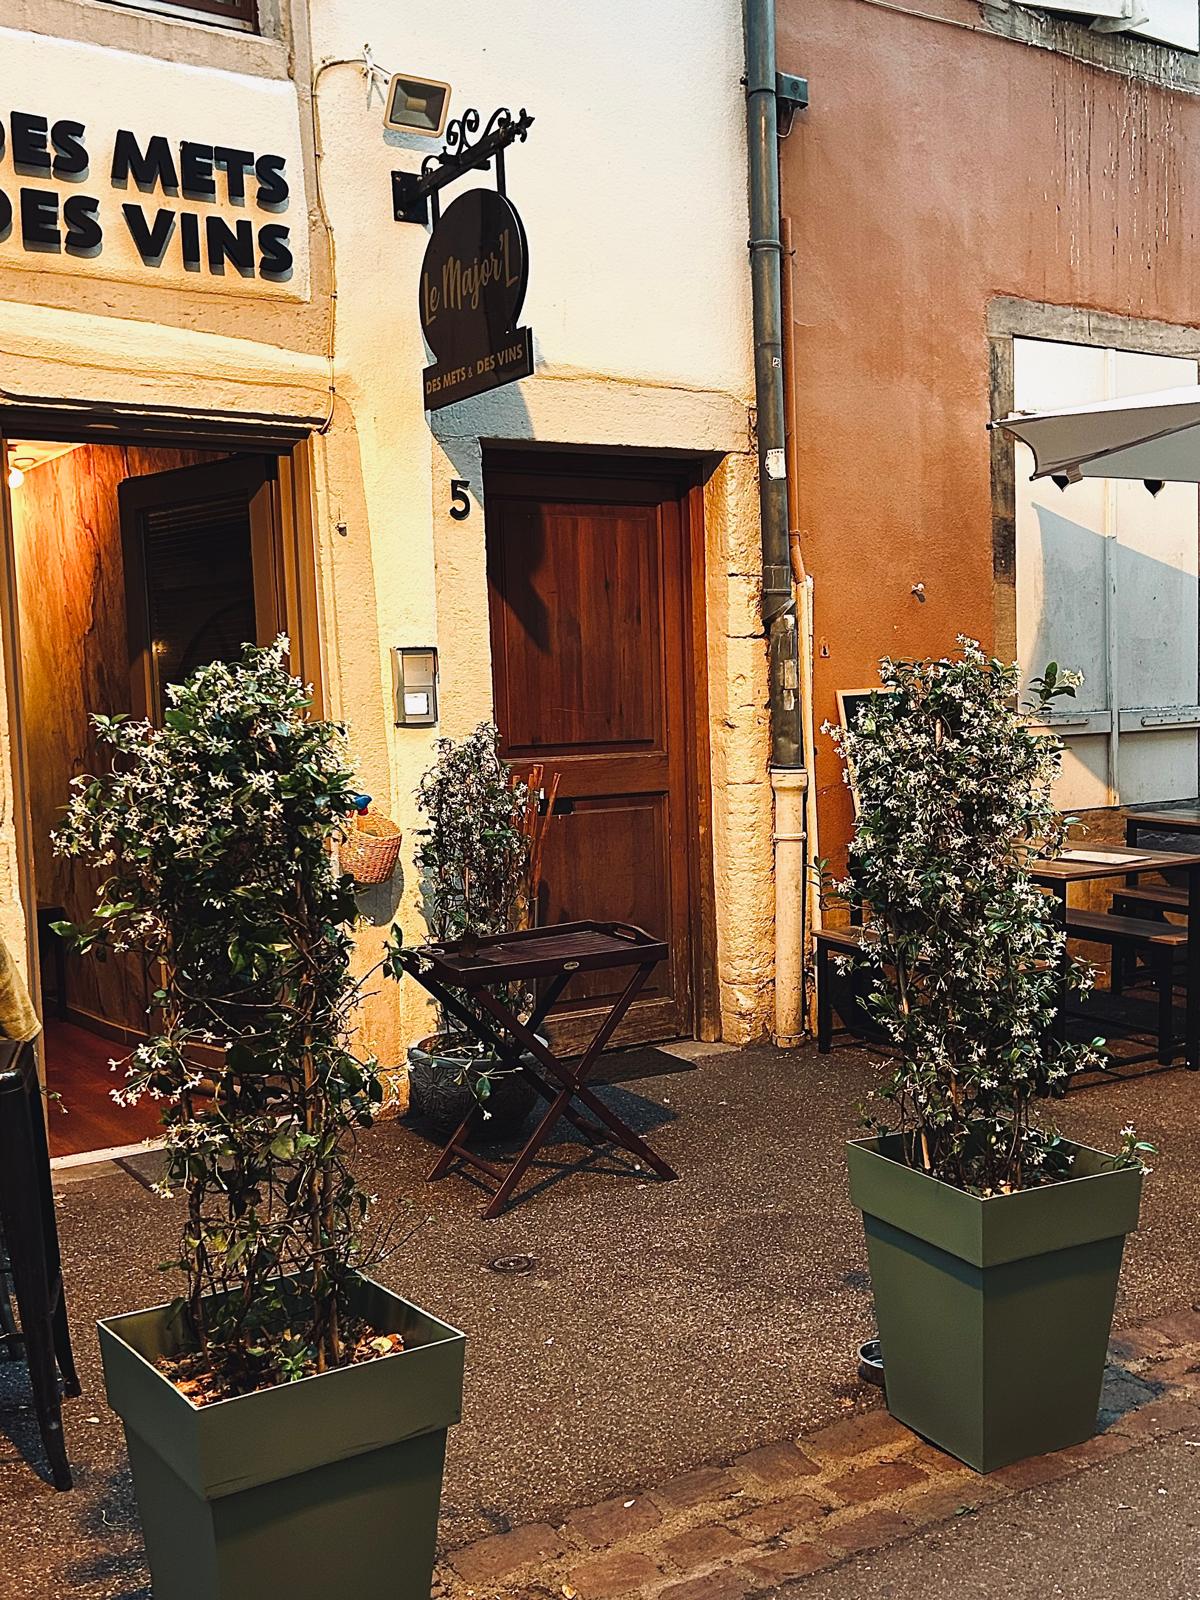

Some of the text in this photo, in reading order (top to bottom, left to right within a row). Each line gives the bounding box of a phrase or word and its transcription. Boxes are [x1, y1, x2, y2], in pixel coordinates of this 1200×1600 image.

[0, 111, 289, 204] ES METS
[122, 203, 293, 273] VINS
[424, 271, 440, 326] Le
[426, 343, 523, 395] DES METS & DES VINS
[449, 479, 471, 521] 5
